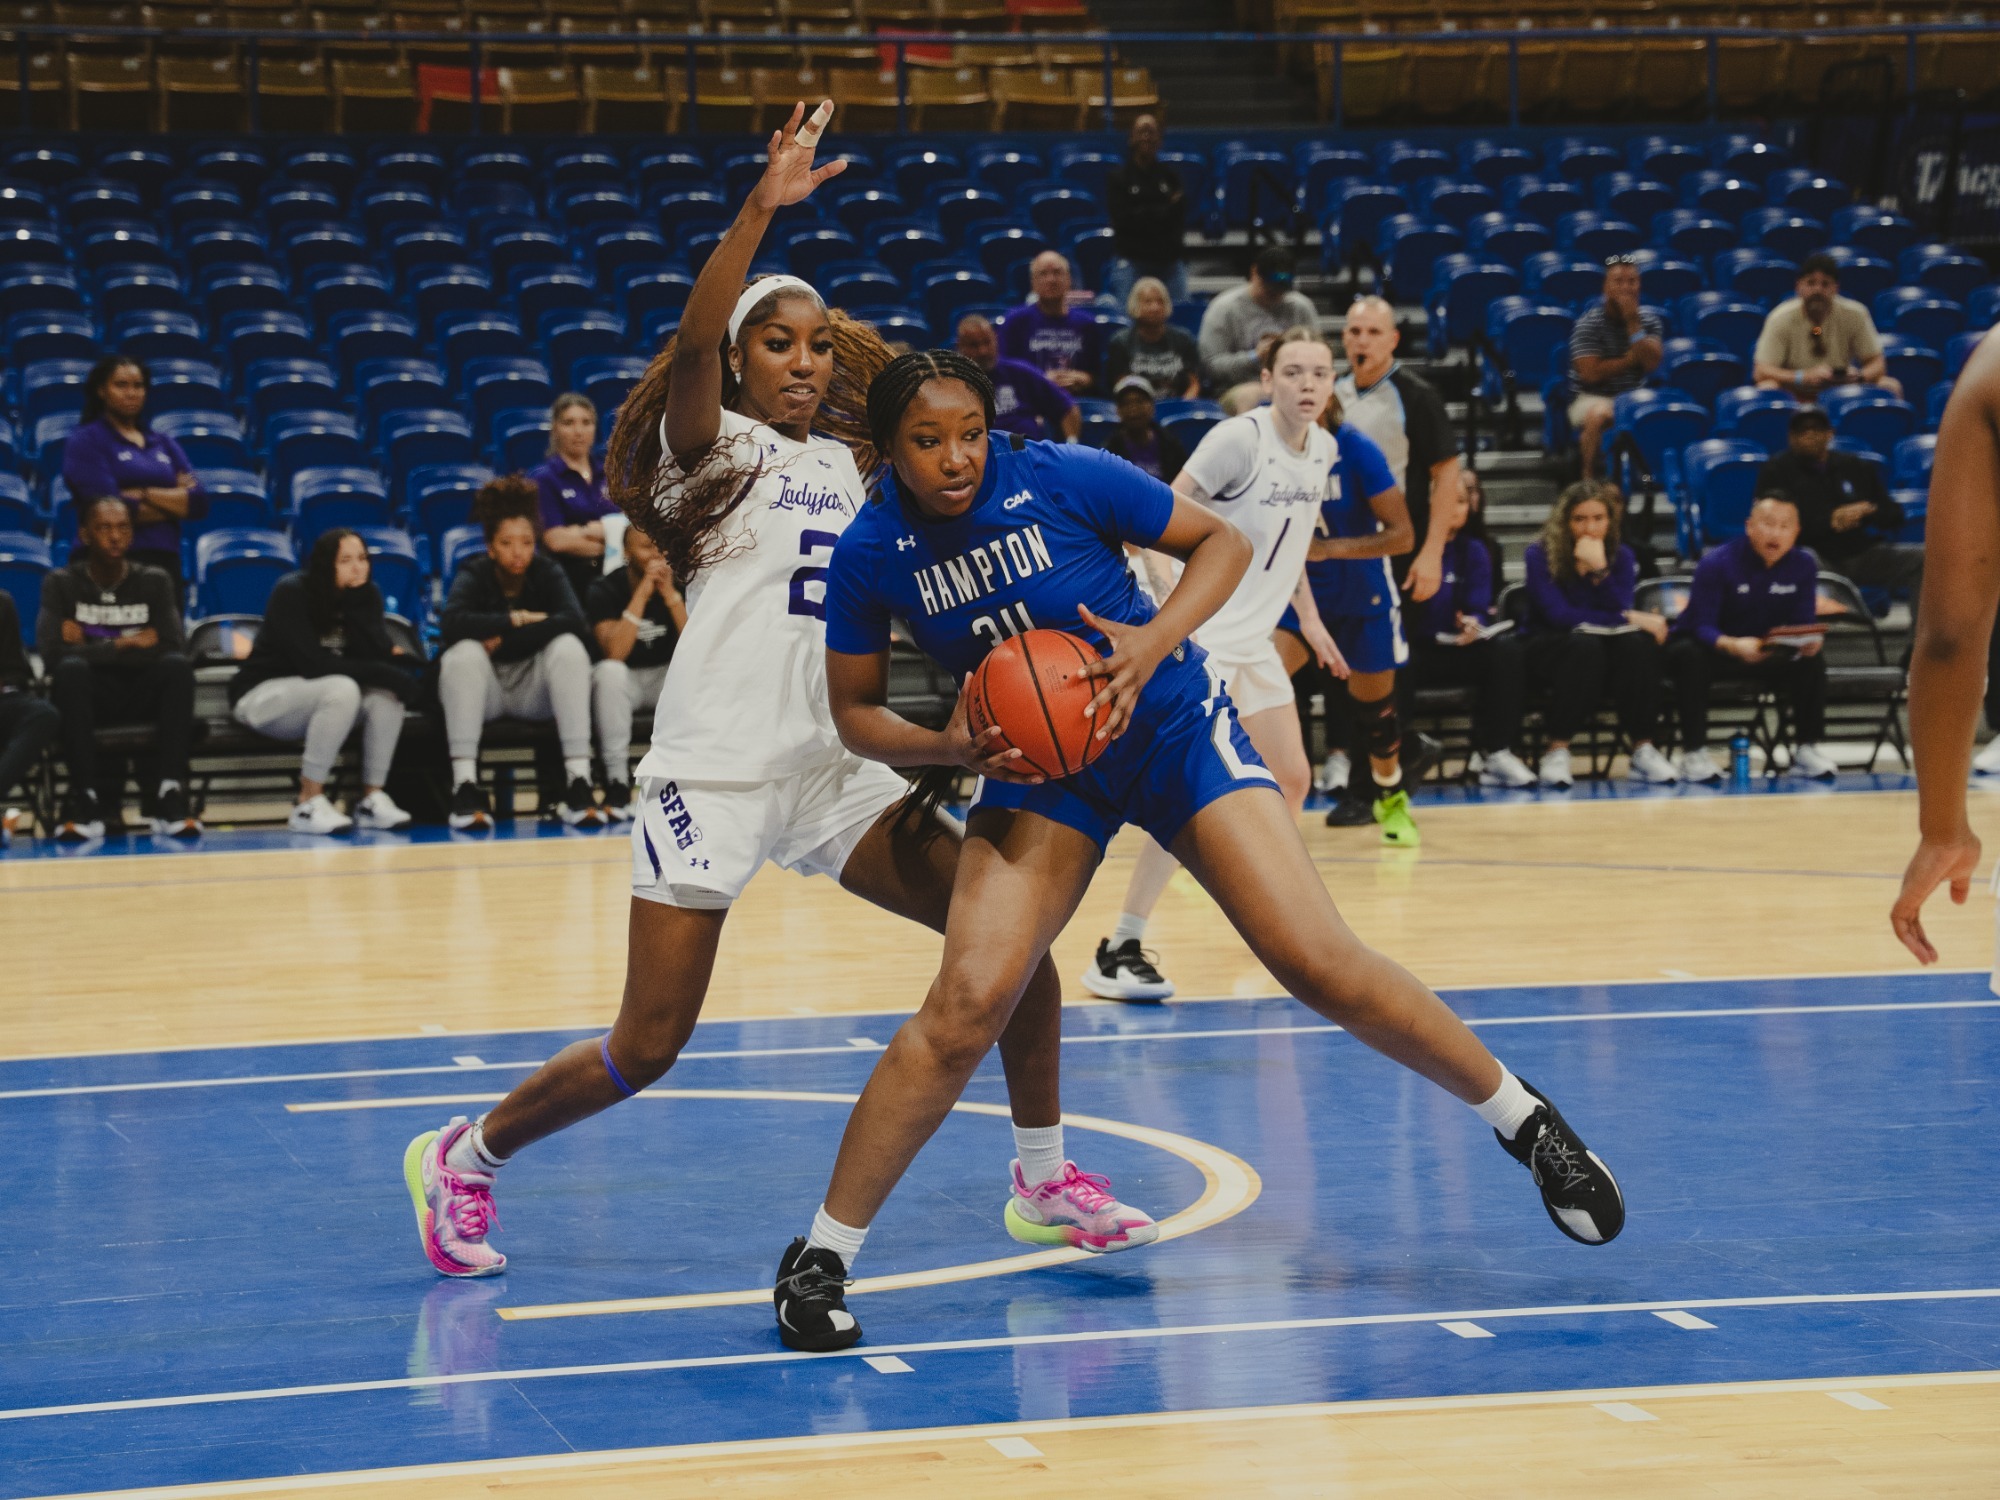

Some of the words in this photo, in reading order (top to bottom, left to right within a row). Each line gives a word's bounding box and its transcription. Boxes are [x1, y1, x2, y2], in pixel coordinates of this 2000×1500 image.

[769, 474, 851, 518] Ladyja
[1003, 489, 1033, 510] CAA
[1259, 482, 1320, 507] Ladyjack
[1265, 517, 1291, 571] 1
[913, 523, 1054, 616] HAMPTON
